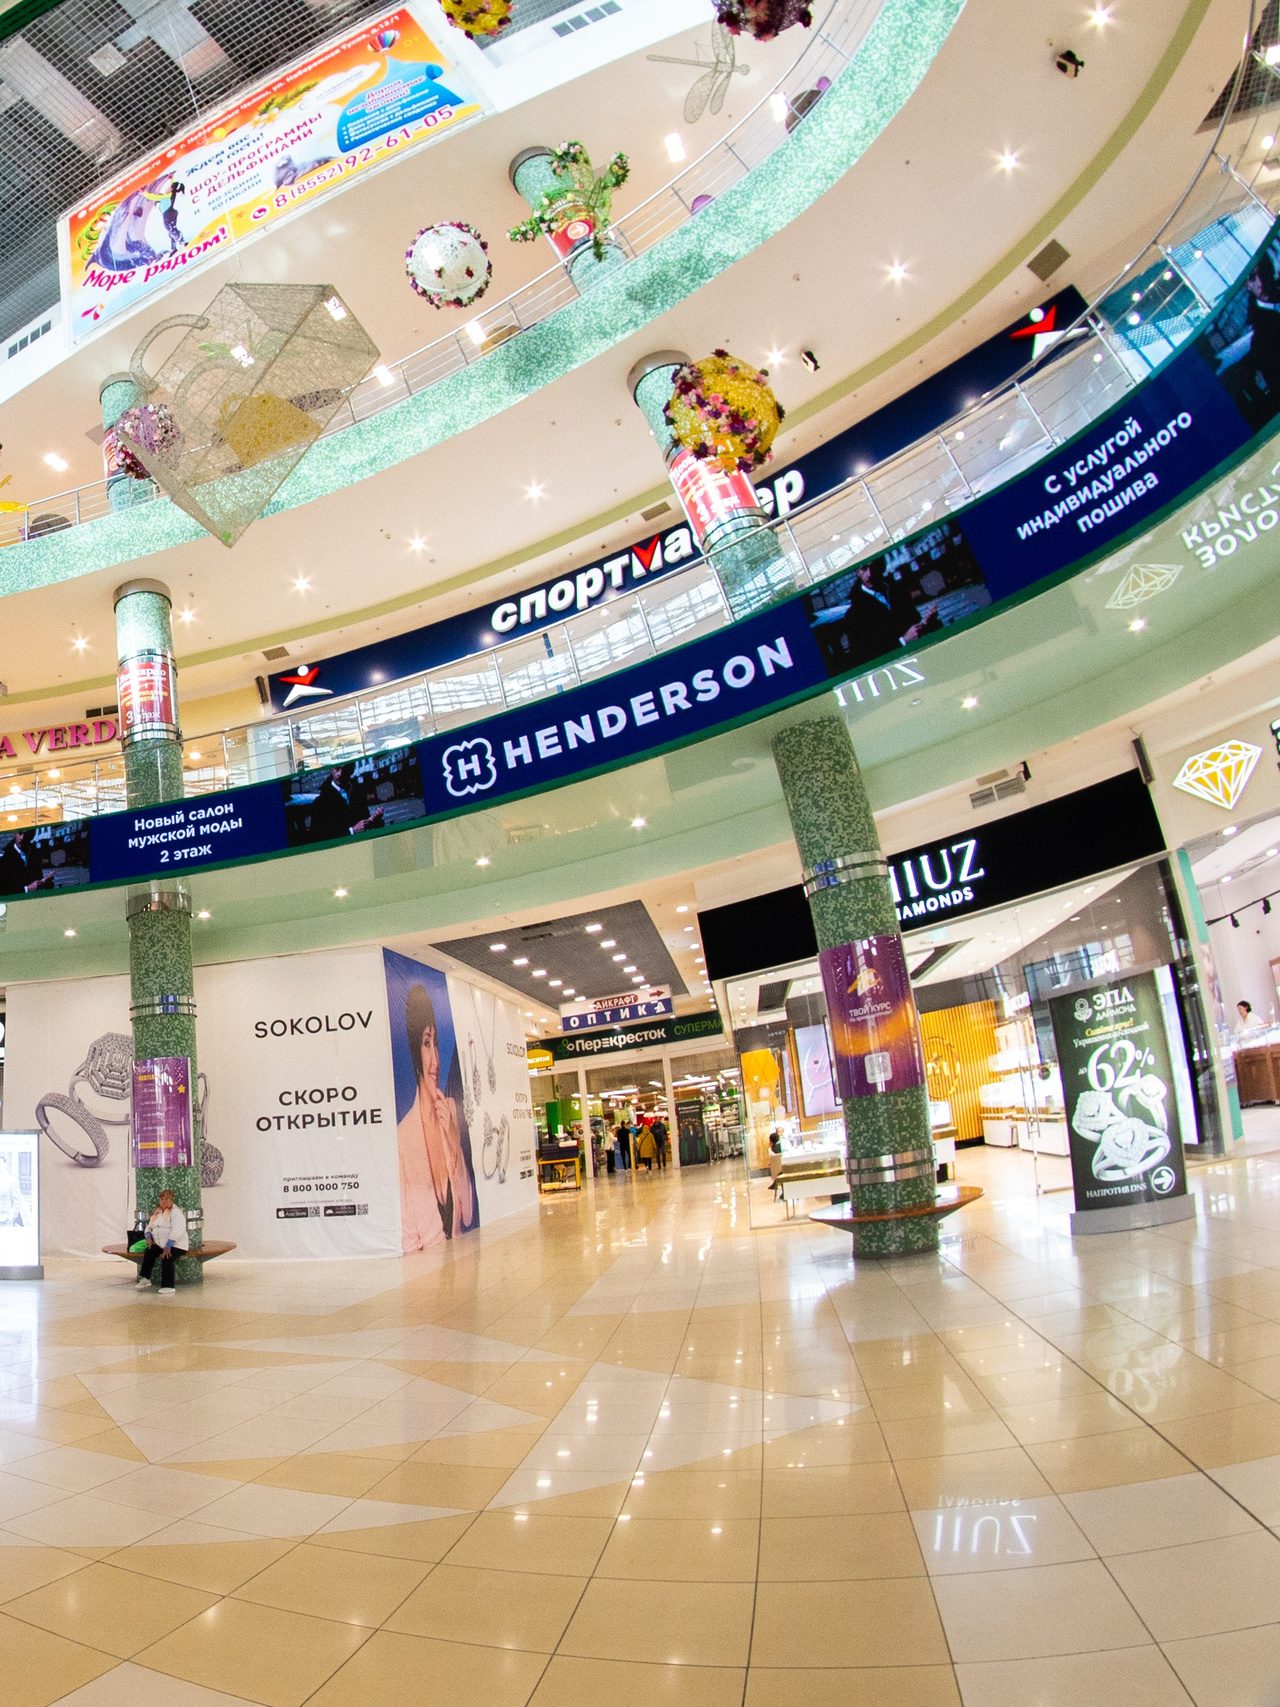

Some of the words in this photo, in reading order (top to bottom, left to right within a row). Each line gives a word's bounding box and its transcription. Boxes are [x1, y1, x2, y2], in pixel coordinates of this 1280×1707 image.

[187, 108, 239, 144] Набережные
[240, 89, 271, 111] Челны,
[272, 81, 285, 92] ул.
[286, 45, 340, 83] Набережная
[185, 150, 224, 177] Ждем
[228, 134, 251, 150] вас
[189, 112, 322, 196] ШОУ-ПРОГРАММЫ
[227, 132, 264, 159] гости!
[207, 128, 313, 197] ДЕЛЬФИНАМИ
[82, 269, 135, 291] Море
[143, 227, 229, 283] рядом!
[1045, 475, 1062, 494] С
[1063, 416, 1143, 487] услугой
[1016, 412, 1193, 540] индивидуального
[1077, 472, 1160, 533] пошива
[126, 710, 134, 724] 3
[458, 755, 480, 780] H
[503, 637, 794, 769] HENDERSON
[22, 718, 122, 754] VERD
[134, 810, 185, 832] Новый
[189, 803, 234, 821] салон
[128, 825, 196, 849] мужской
[200, 818, 243, 836] моды
[160, 850, 170, 863] 2
[173, 844, 212, 860] этаж
[895, 886, 974, 921] IAMONDS
[595, 994, 636, 1010] АЙКРАФТ
[849, 1002, 869, 1017] ТВОЙ
[871, 1001, 892, 1013] КУРС
[1093, 986, 1134, 1009] ЭПЛ
[1096, 1003, 1136, 1021] ДАЙМОНД
[254, 1010, 373, 1039] SOKOLOV
[570, 1002, 666, 1028] ОПТИКА
[278, 1086, 357, 1106] СКОРО
[256, 1108, 382, 1132] ОТКРЫТИЕ
[283, 1185, 289, 1193] 8
[292, 1184, 312, 1192] 800
[315, 1183, 338, 1191] 1000
[341, 1181, 360, 1190] 750
[331, 1173, 359, 1181] команду
[1086, 1184, 1130, 1198] НАПРОТИВ
[1130, 1182, 1147, 1194] DNS
